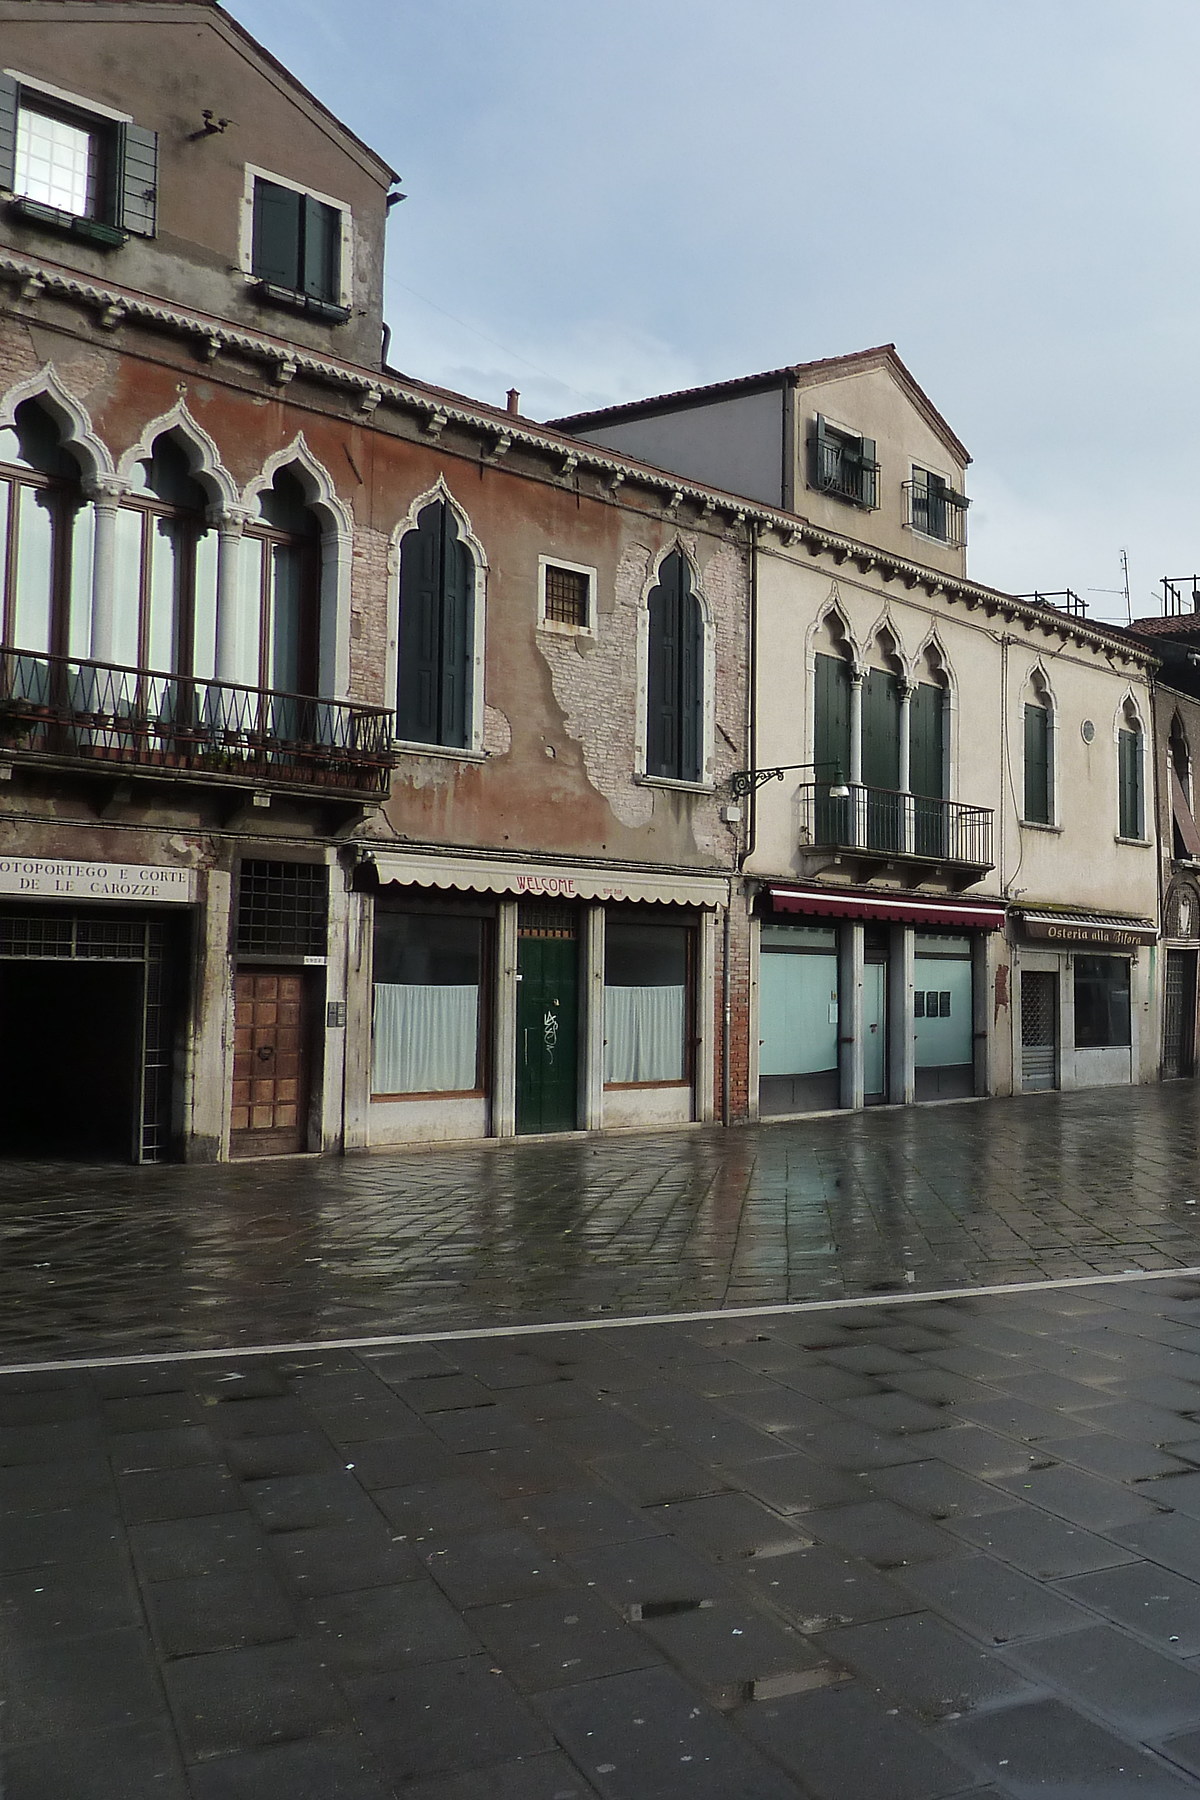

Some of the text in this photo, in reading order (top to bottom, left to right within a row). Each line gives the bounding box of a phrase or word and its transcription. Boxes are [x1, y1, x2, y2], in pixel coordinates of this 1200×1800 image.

[0, 861, 187, 883] OTOPORTEGO E CORTE
[20, 878, 160, 897] DE LE CAROZZE
[516, 876, 575, 893] WELCOME
[1048, 926, 1141, 945] Osteria alla Bifora
